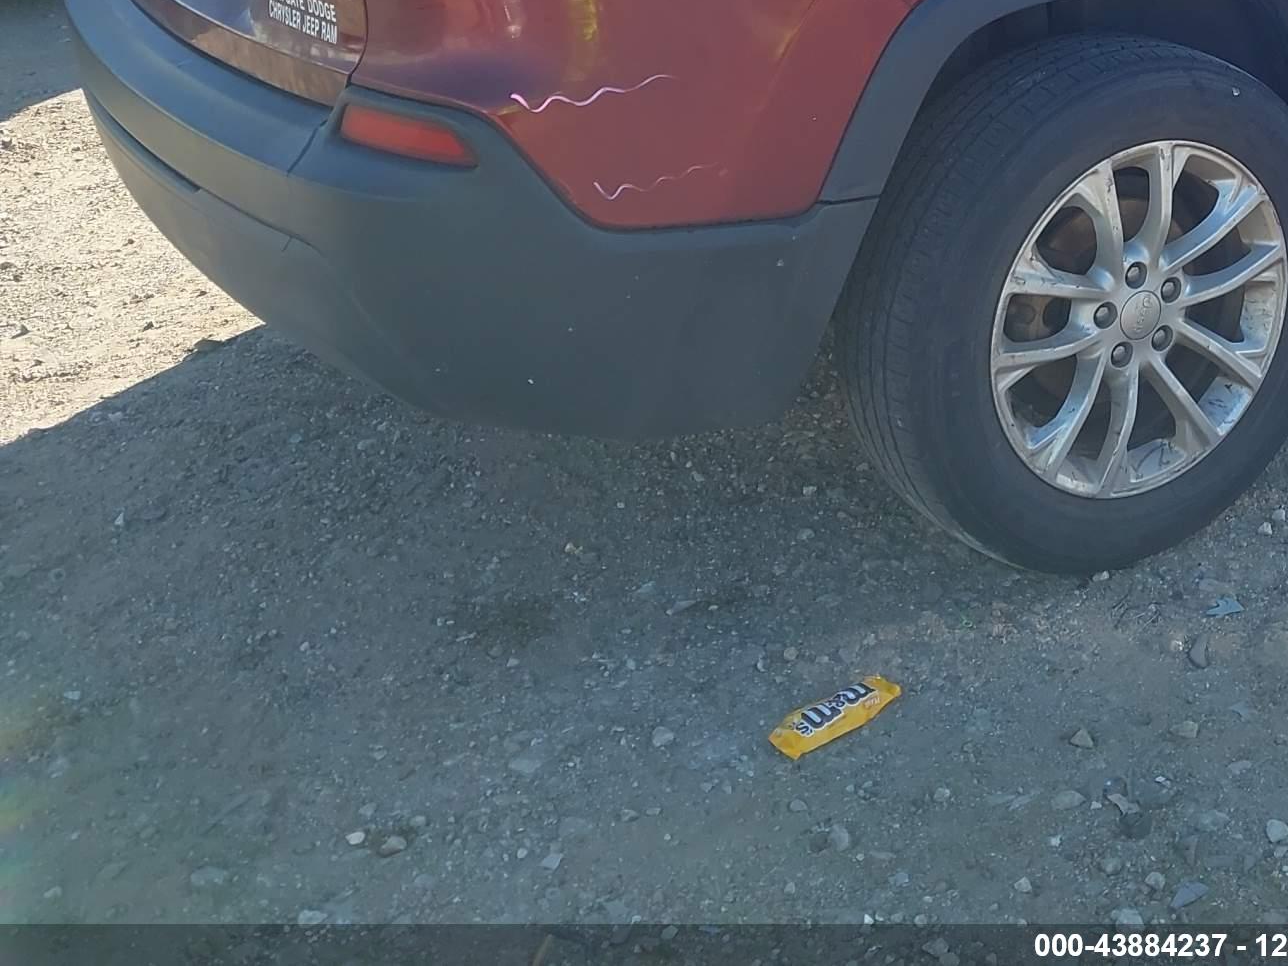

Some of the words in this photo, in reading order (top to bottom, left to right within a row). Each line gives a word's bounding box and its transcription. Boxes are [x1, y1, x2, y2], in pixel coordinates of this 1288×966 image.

[268, 0, 301, 30] CHRYSLER
[302, 14, 320, 37] JEEP
[320, 22, 338, 45] RAM
